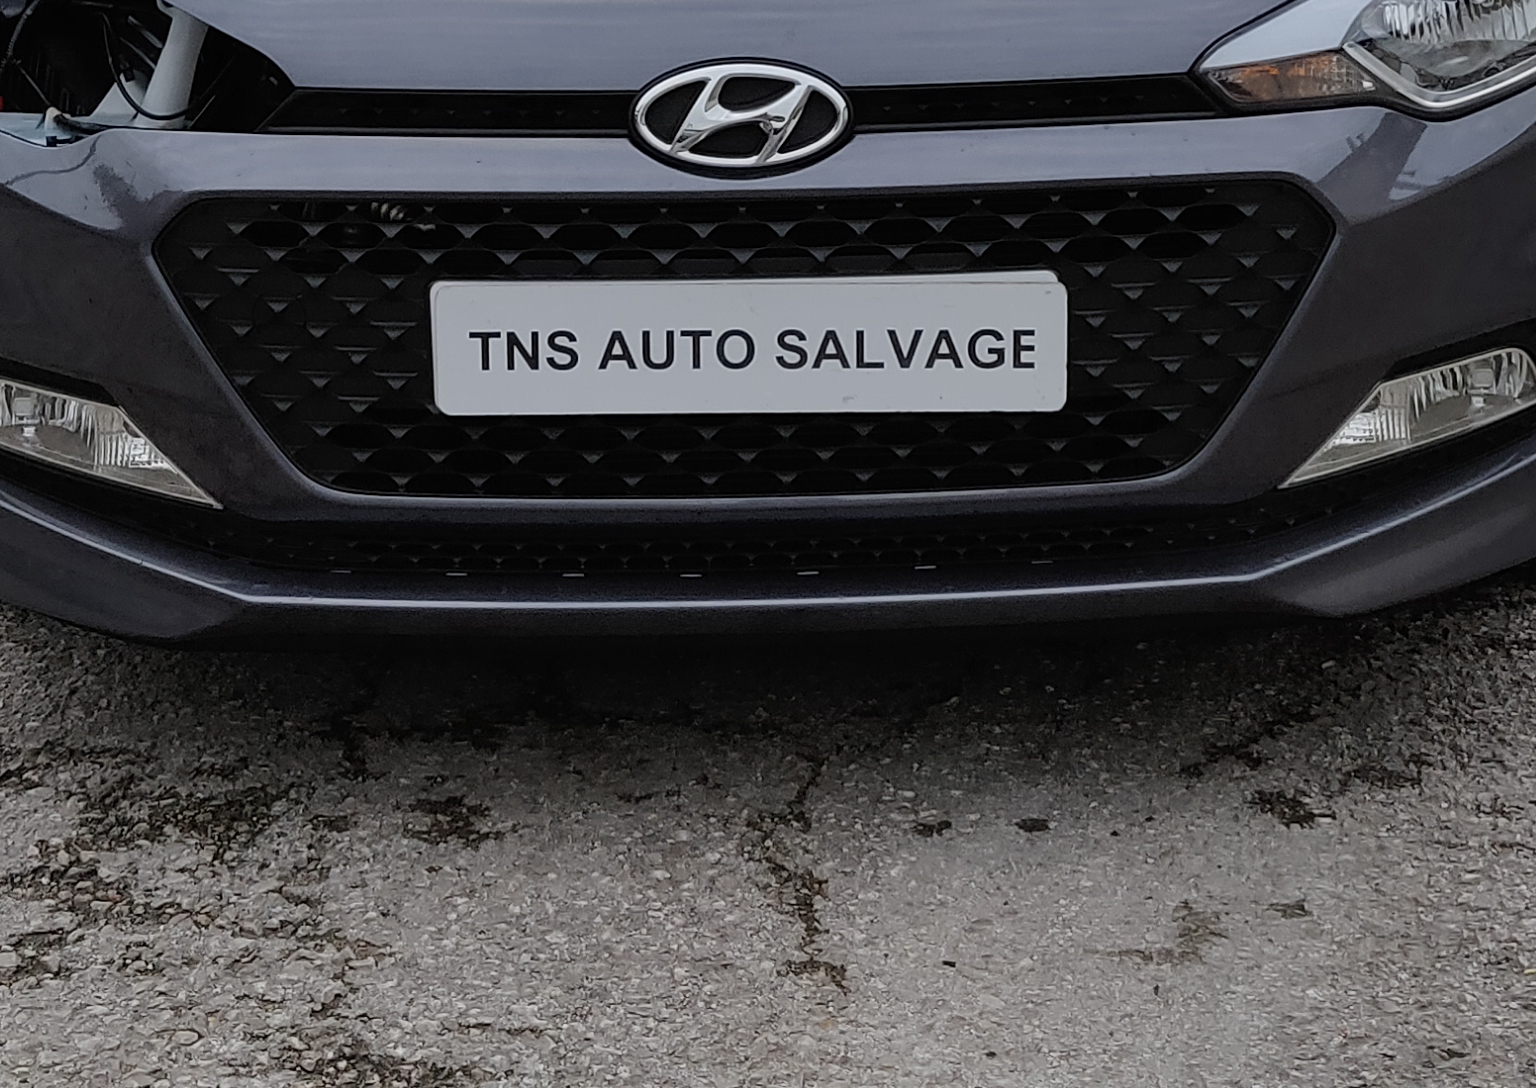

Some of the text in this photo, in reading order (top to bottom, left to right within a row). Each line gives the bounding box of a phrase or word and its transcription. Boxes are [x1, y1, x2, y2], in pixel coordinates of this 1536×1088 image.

[468, 328, 1037, 372] TNS AUTO SALVAGE
